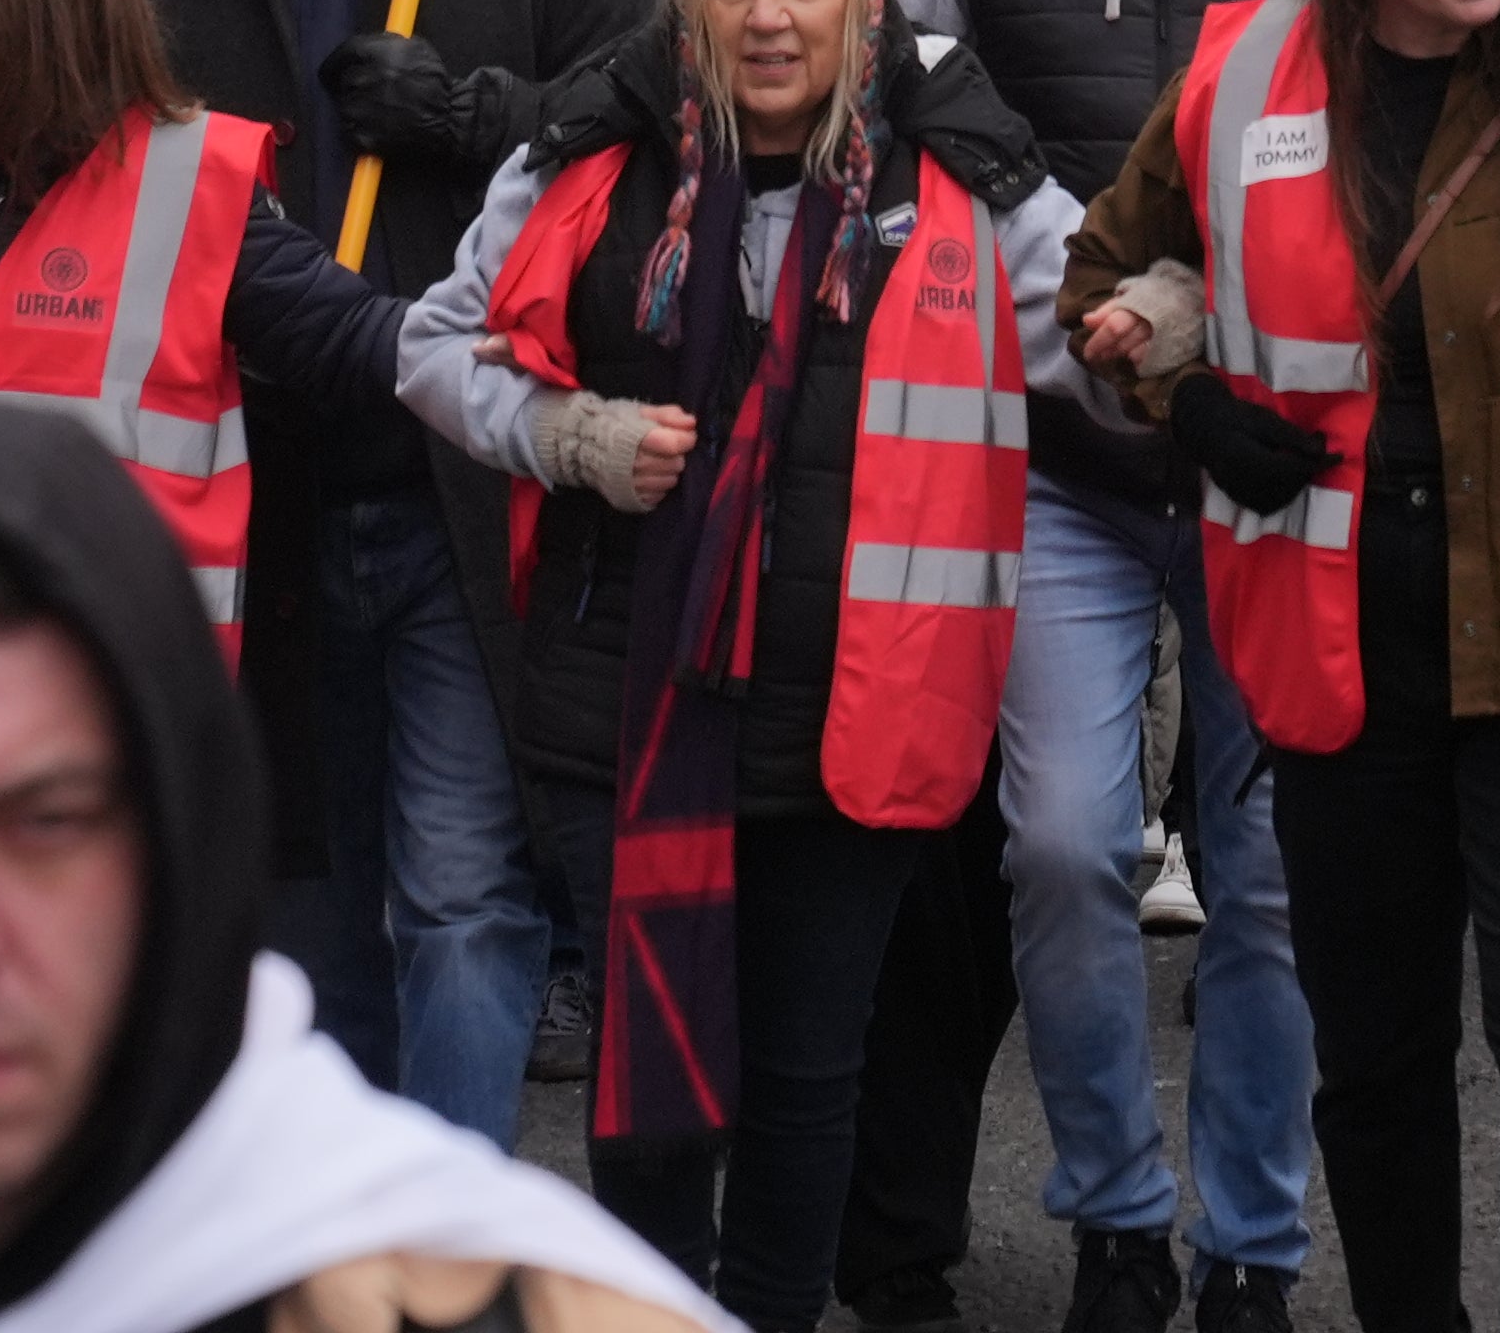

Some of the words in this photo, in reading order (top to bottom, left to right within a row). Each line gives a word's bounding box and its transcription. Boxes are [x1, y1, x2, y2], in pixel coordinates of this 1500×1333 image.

[1266, 133, 1271, 146] I
[1276, 131, 1306, 147] AM
[1254, 144, 1319, 168] TOMMY
